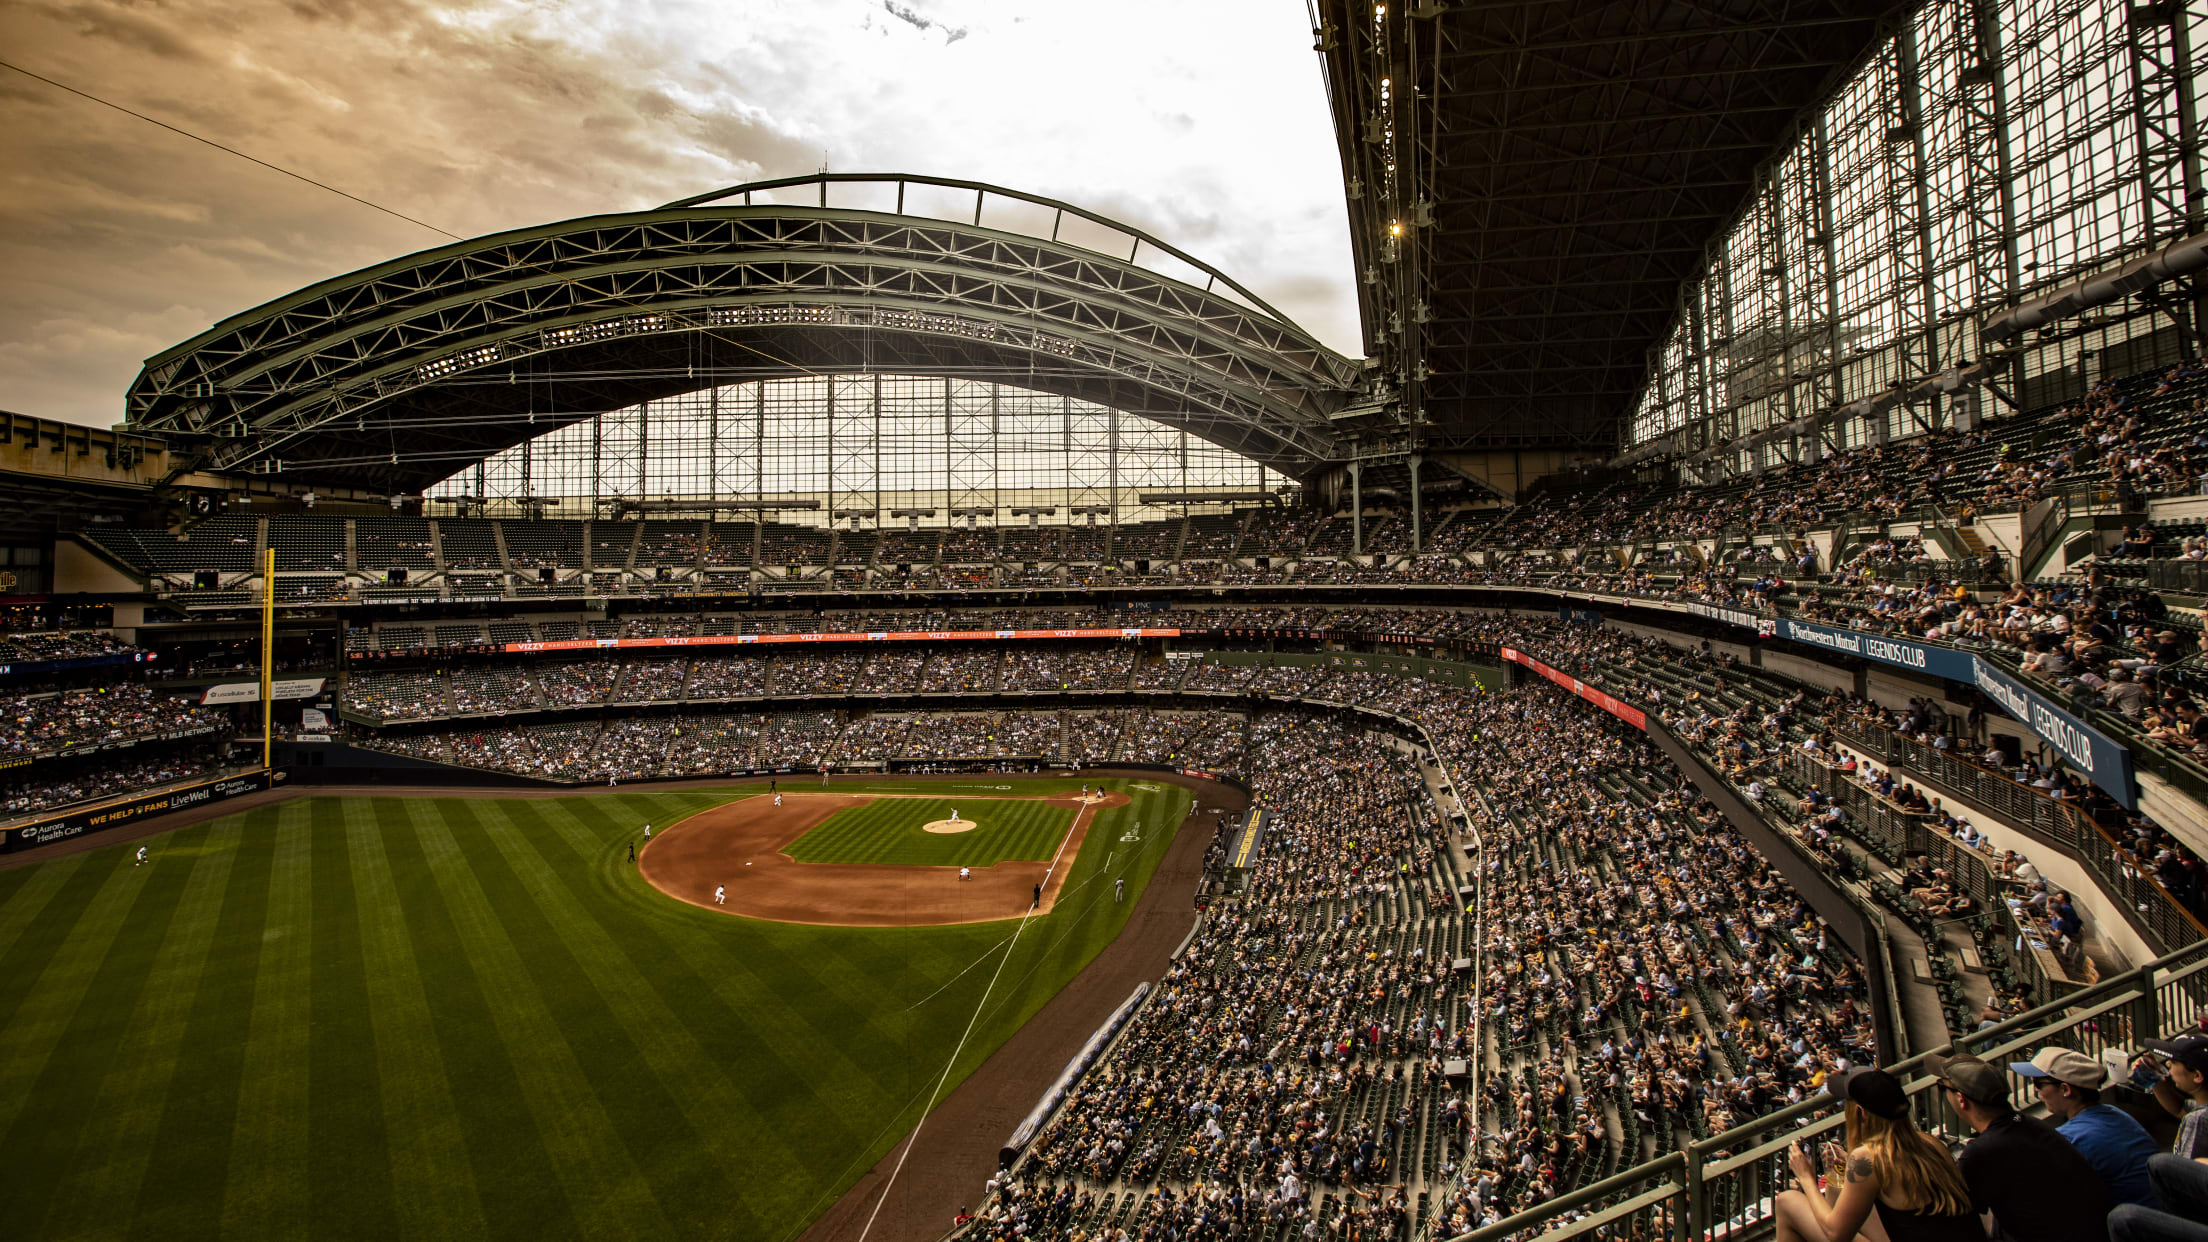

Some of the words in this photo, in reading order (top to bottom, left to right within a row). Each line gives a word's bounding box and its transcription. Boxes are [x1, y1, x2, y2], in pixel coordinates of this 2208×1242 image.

[1794, 623, 1835, 647] Northwestern
[1834, 631, 1859, 652] Mutual
[1865, 640, 1901, 663] LEGENDS
[1902, 646, 1926, 668] CLUB
[169, 730, 182, 740] MLB
[183, 725, 215, 737] NETWORK
[2032, 702, 2069, 752] LEGENDS
[2067, 725, 2094, 772] CLUB
[226, 780, 245, 788] Aurora
[226, 785, 246, 796] Health
[246, 783, 258, 791] Care
[171, 789, 210, 808] LiveWell
[90, 814, 106, 826] WE
[109, 808, 134, 822] HELP
[144, 800, 168, 813] FANS
[37, 829, 64, 843] Health
[64, 825, 83, 839] Care
[39, 822, 64, 833] Aurora
